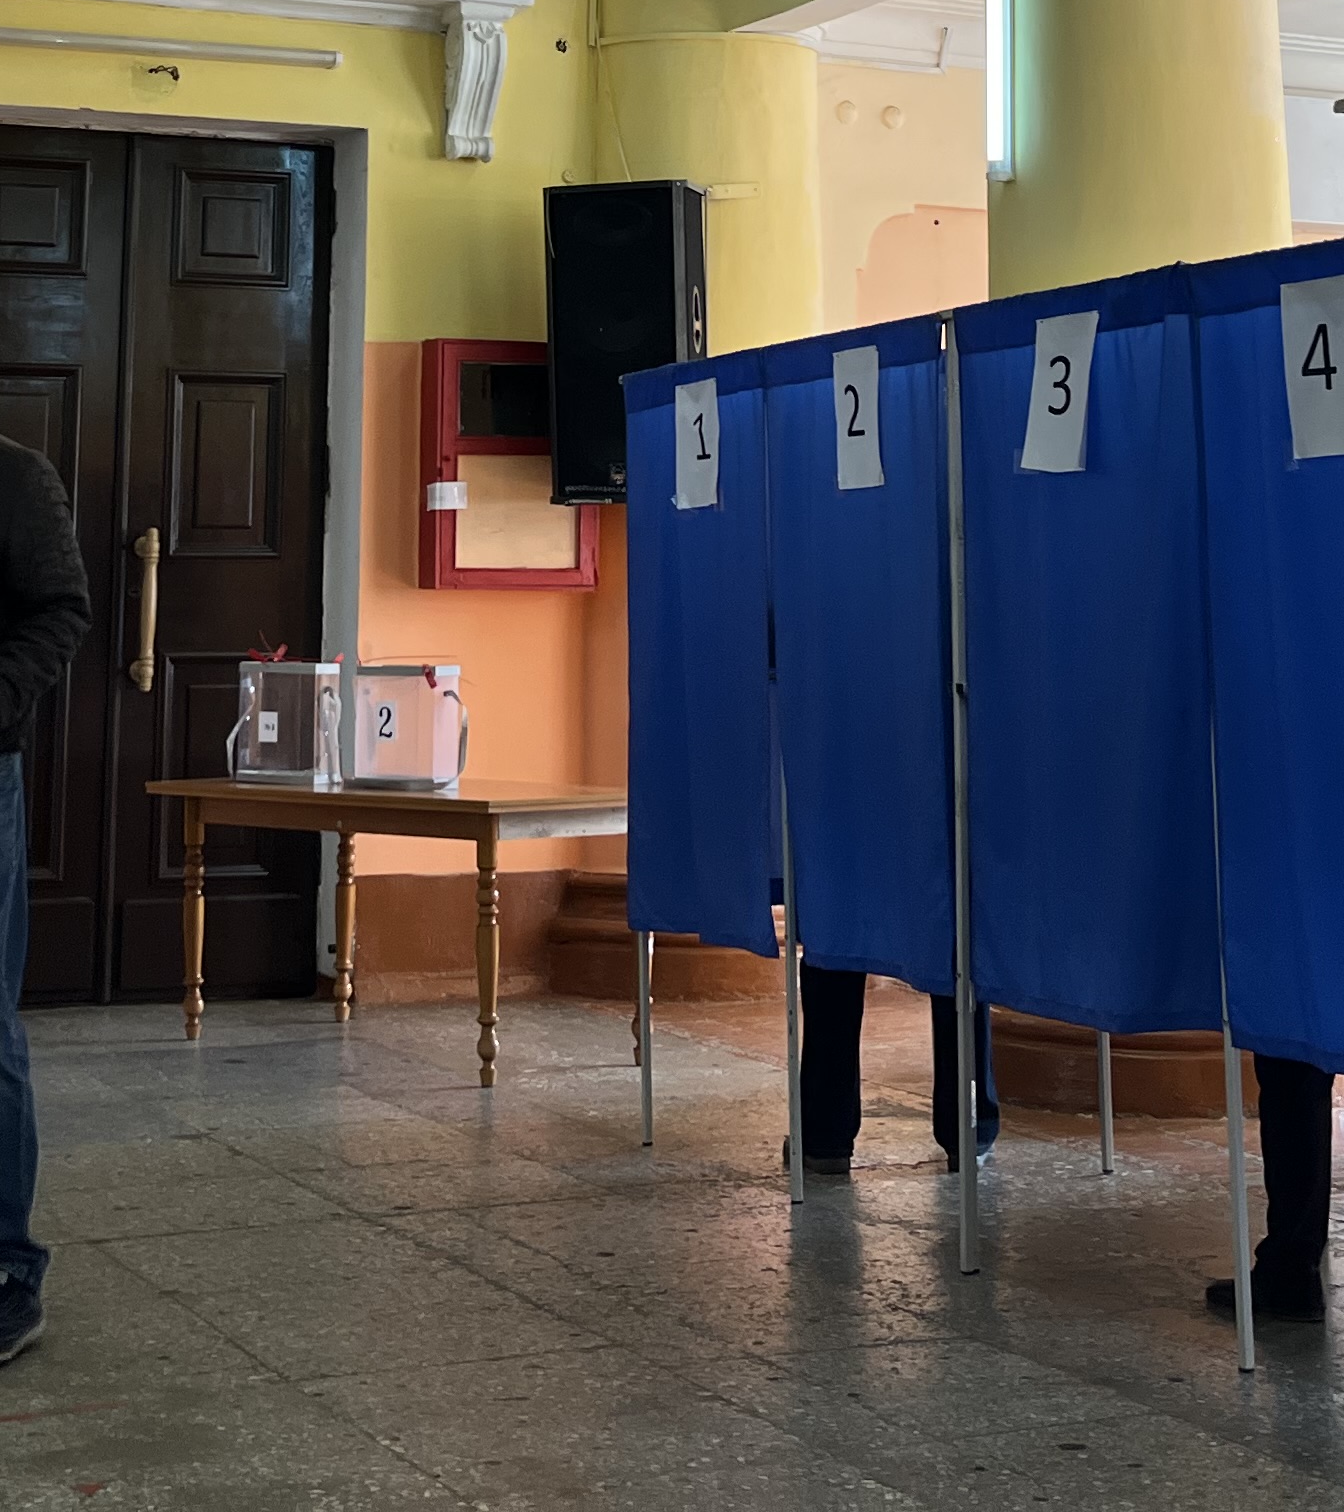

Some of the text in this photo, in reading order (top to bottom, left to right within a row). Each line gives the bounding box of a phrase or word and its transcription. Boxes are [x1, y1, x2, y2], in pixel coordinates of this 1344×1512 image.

[1301, 323, 1338, 391] 4
[844, 384, 866, 438] 2
[1047, 355, 1072, 416] 3
[693, 412, 712, 461] 1
[379, 706, 393, 738] 2
